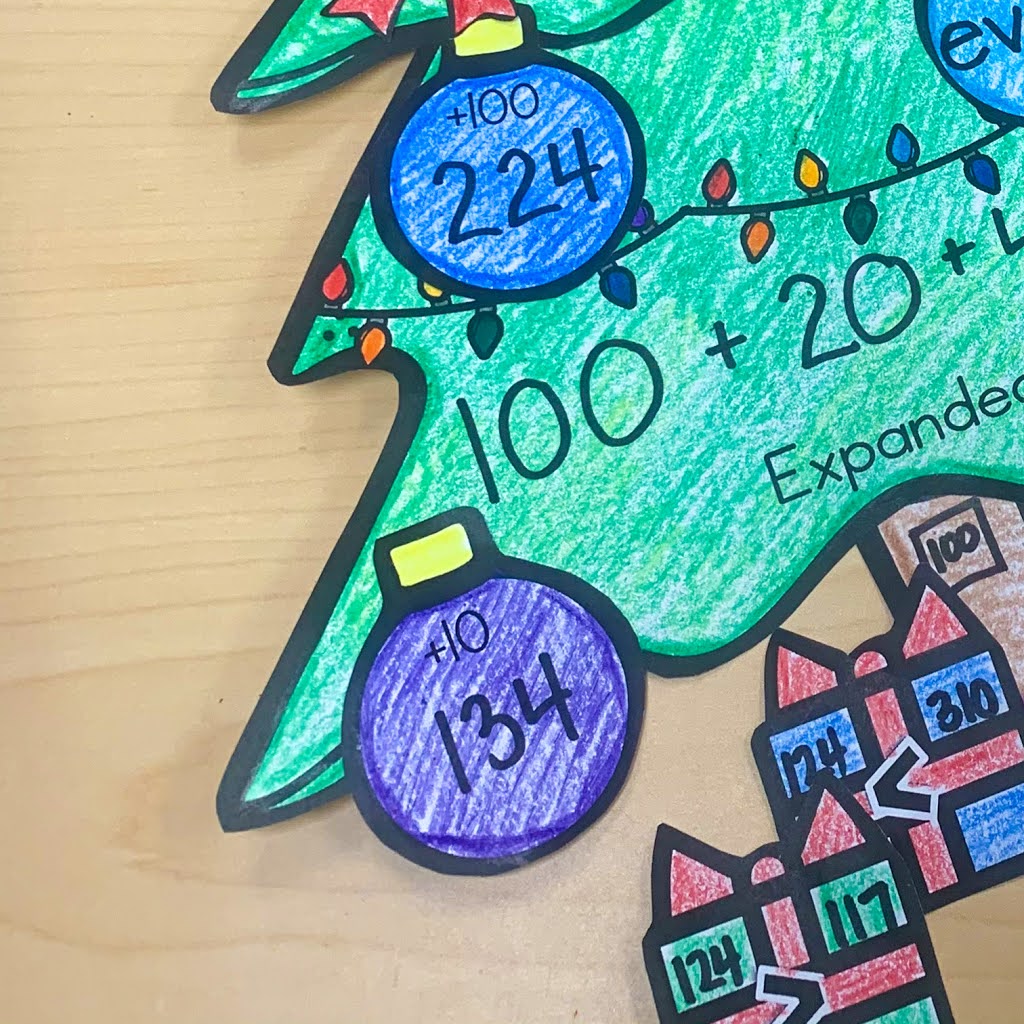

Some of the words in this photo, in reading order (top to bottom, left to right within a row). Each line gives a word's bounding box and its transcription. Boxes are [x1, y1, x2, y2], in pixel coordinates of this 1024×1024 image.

[447, 82, 540, 129] +100
[432, 127, 604, 245] 224
[456, 338, 665, 504] 100
[778, 253, 922, 369] 20
[926, 522, 981, 574] 100
[424, 608, 491, 666] +10
[434, 651, 581, 794] 134
[926, 677, 999, 734] 310
[671, 934, 744, 1005] 124
[825, 880, 897, 950] 117
